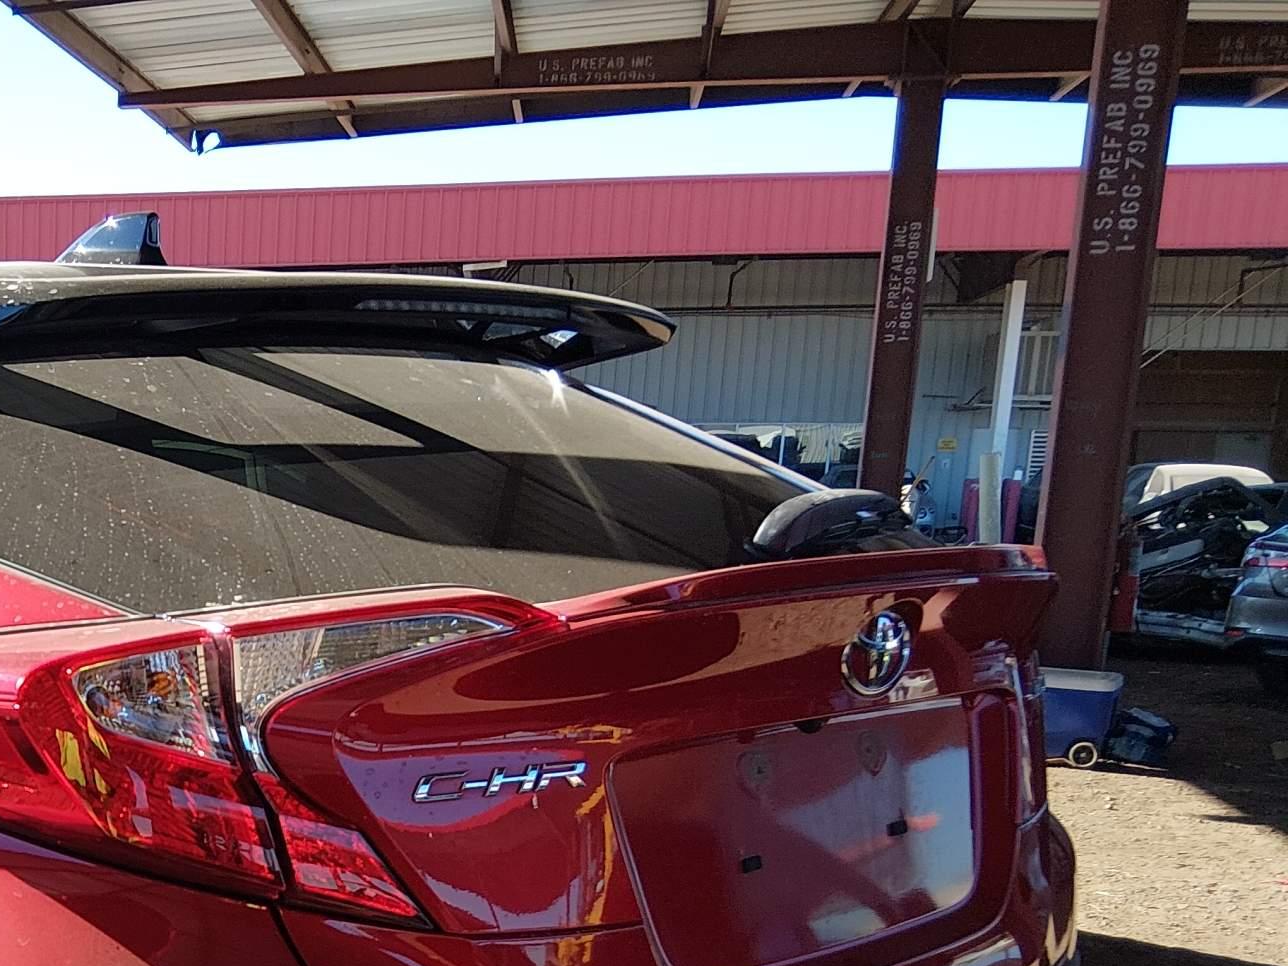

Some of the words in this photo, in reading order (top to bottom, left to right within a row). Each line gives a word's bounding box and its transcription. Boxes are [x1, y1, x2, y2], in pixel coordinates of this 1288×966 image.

[571, 56, 625, 71] PREFAB
[1109, 50, 1134, 89] INC
[1096, 101, 1128, 196] PREFAB
[1115, 43, 1161, 253] 1-866-799-0969
[1089, 209, 1114, 255] U.S.
[886, 254, 905, 310] PREFAB
[896, 221, 922, 342] 1-866-799-0969
[883, 315, 898, 343] U.S.
[412, 760, 587, 803] C-HR
